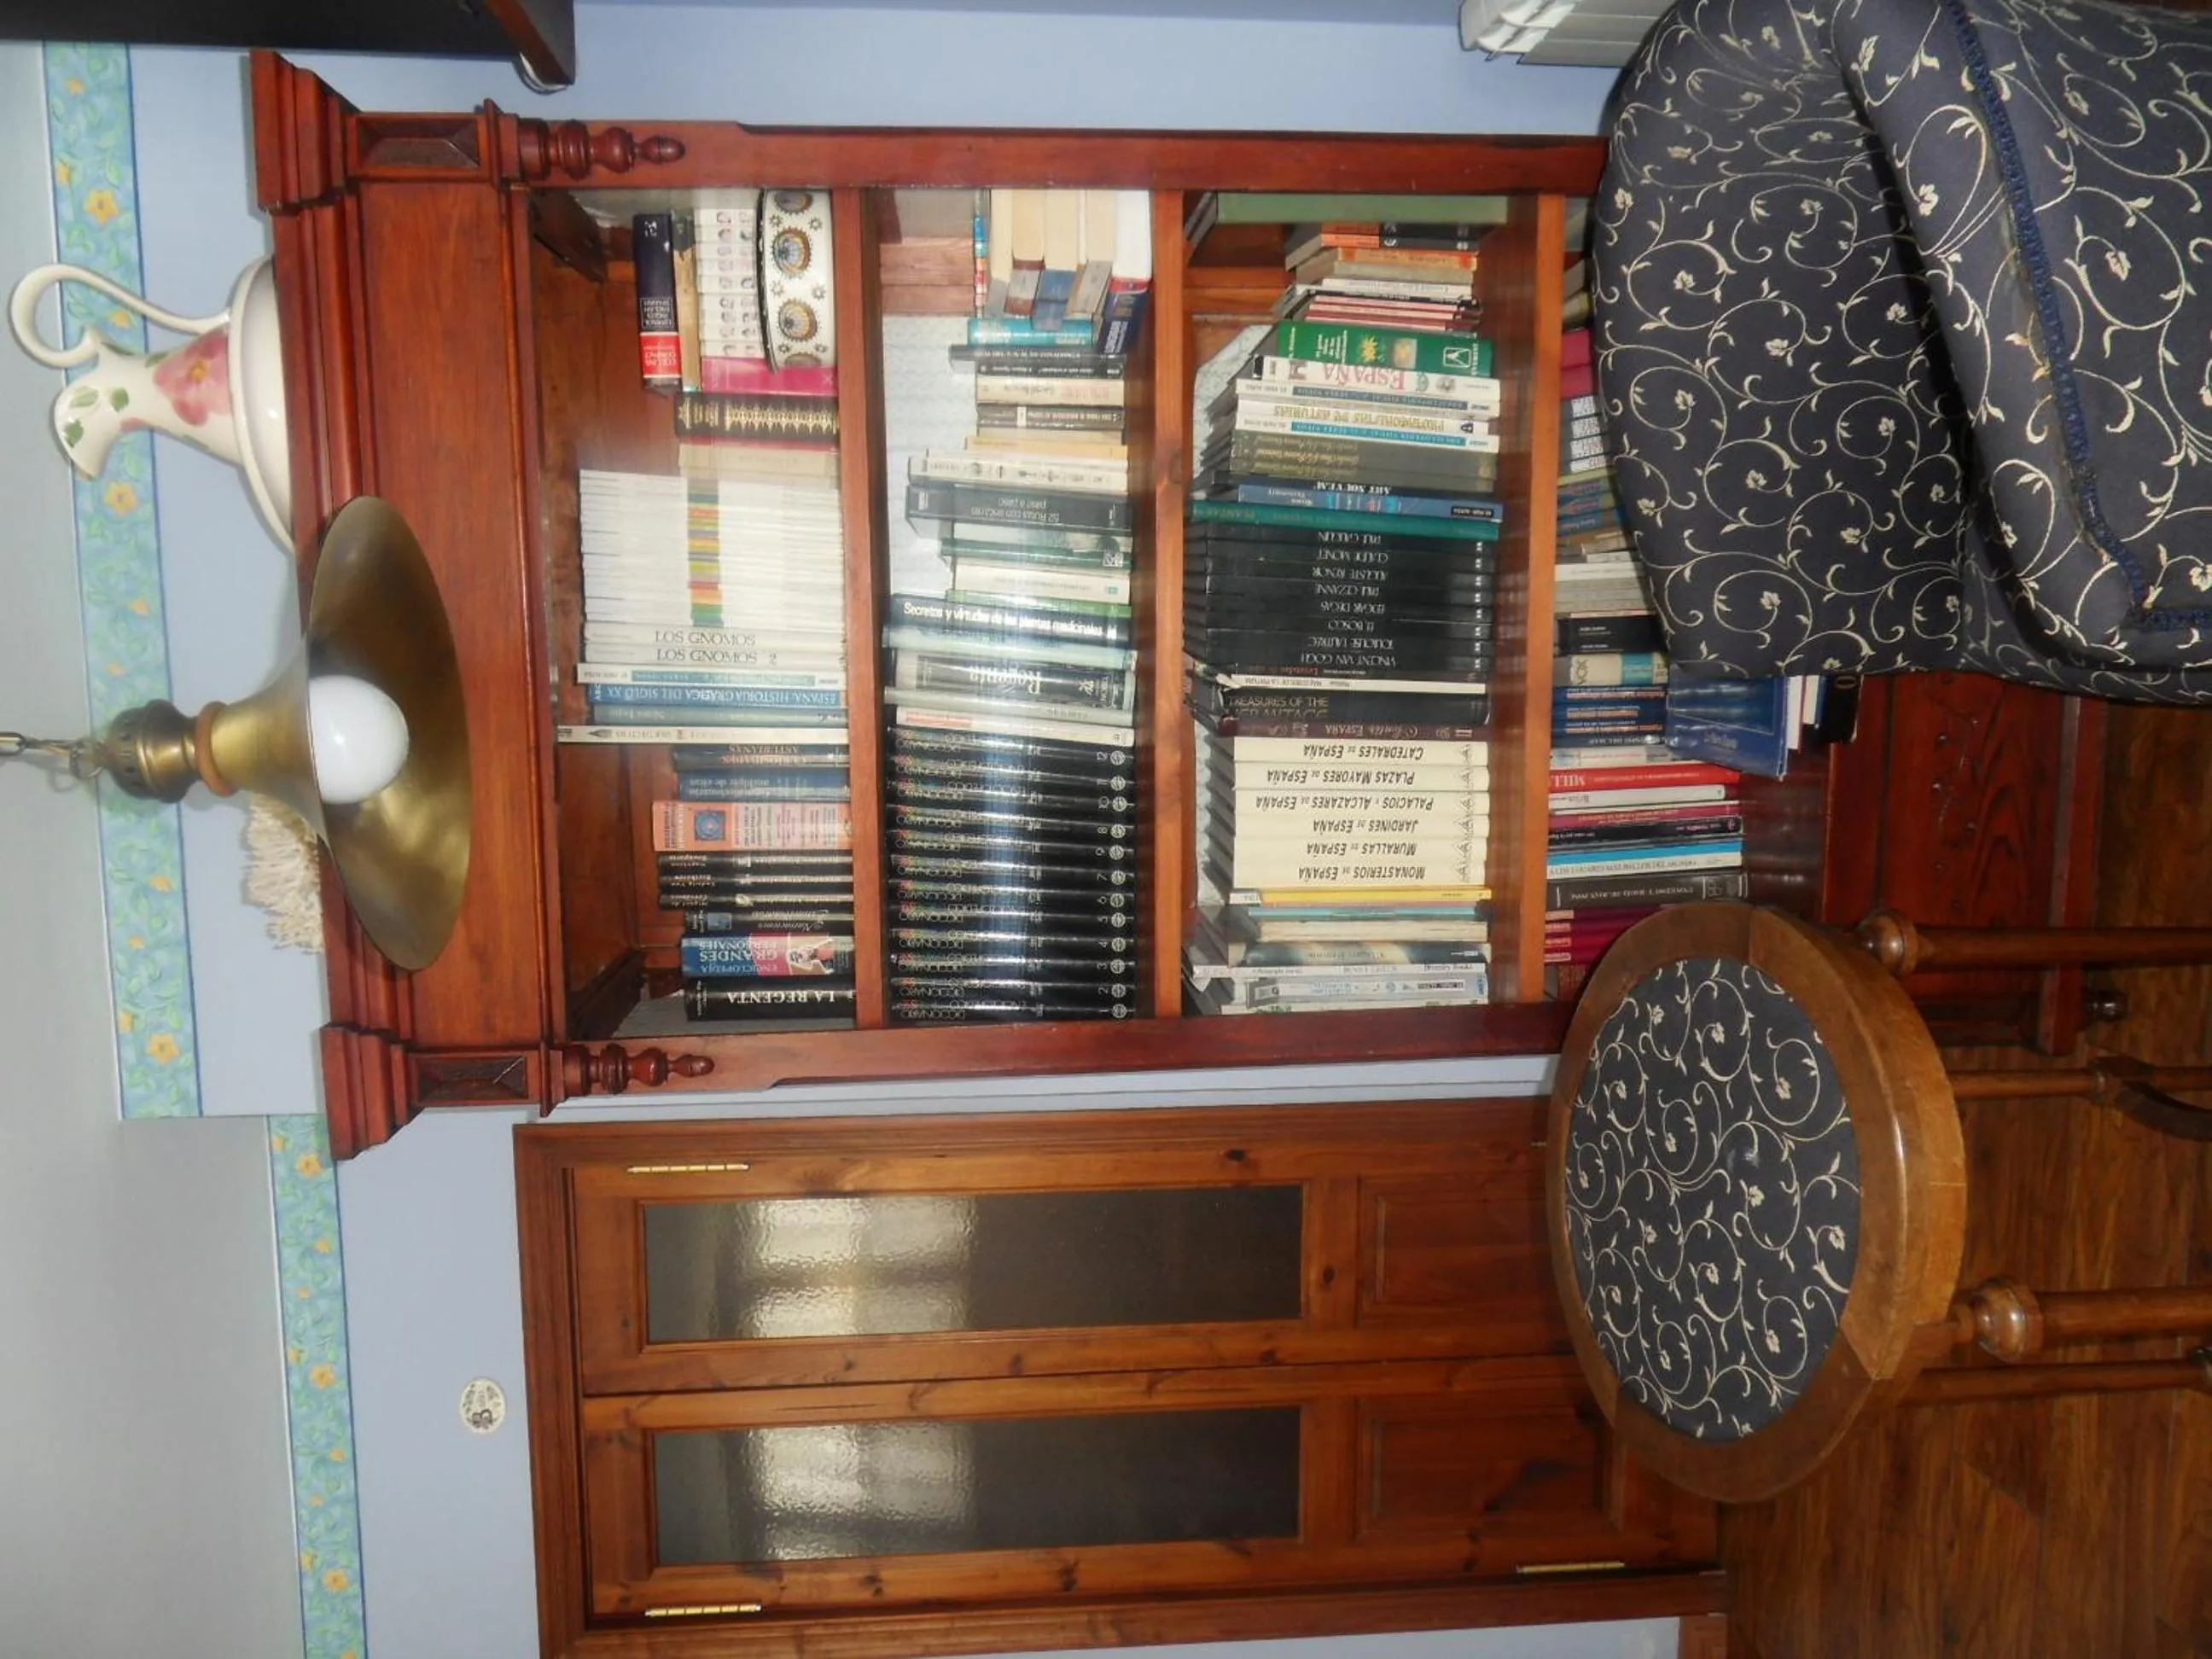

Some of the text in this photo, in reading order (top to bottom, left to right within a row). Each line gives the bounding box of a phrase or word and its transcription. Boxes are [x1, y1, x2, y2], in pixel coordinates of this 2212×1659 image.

[1321, 362, 1406, 393] ESPAÑA
[1367, 485, 1391, 496] ART
[1316, 549, 1389, 562] CLAUDE MONET
[1320, 601, 1386, 614] EDGAR DEGAS
[1328, 620, 1364, 630] BOSCO
[655, 630, 756, 645] LOS GNOMOS
[656, 649, 685, 662] LOS
[690, 649, 758, 662] GNOMOS
[1301, 652, 1396, 666] VINCENT VAN GOGH
[607, 686, 621, 696] XX
[625, 688, 659, 701] SIGLO
[659, 687, 682, 700] DEL
[735, 690, 789, 703] HISTORIA
[1229, 696, 1328, 707] TREASURES OF THE
[1303, 744, 1345, 760] ESPAÑA
[1359, 746, 1424, 760] CATEDRALES
[1266, 770, 1308, 785] ESPAÑA
[1323, 770, 1372, 783] MAYORES
[1375, 770, 1415, 785] PLAZAS
[1255, 795, 1297, 811] ESPAÑA
[1311, 795, 1372, 810] ALCAZARES
[1382, 797, 1434, 811] PALACIOS
[1313, 819, 1353, 834] ESPAÑA
[1369, 819, 1418, 833] JARDINES
[1307, 842, 1347, 857] ESPAÑA
[1362, 842, 1417, 857] MURALLAS
[1297, 866, 1339, 882] ESPAÑA
[1352, 866, 1426, 881] MONASTERIOS
[700, 949, 778, 961] GRANDES
[725, 990, 835, 1004] LA REGENTA
